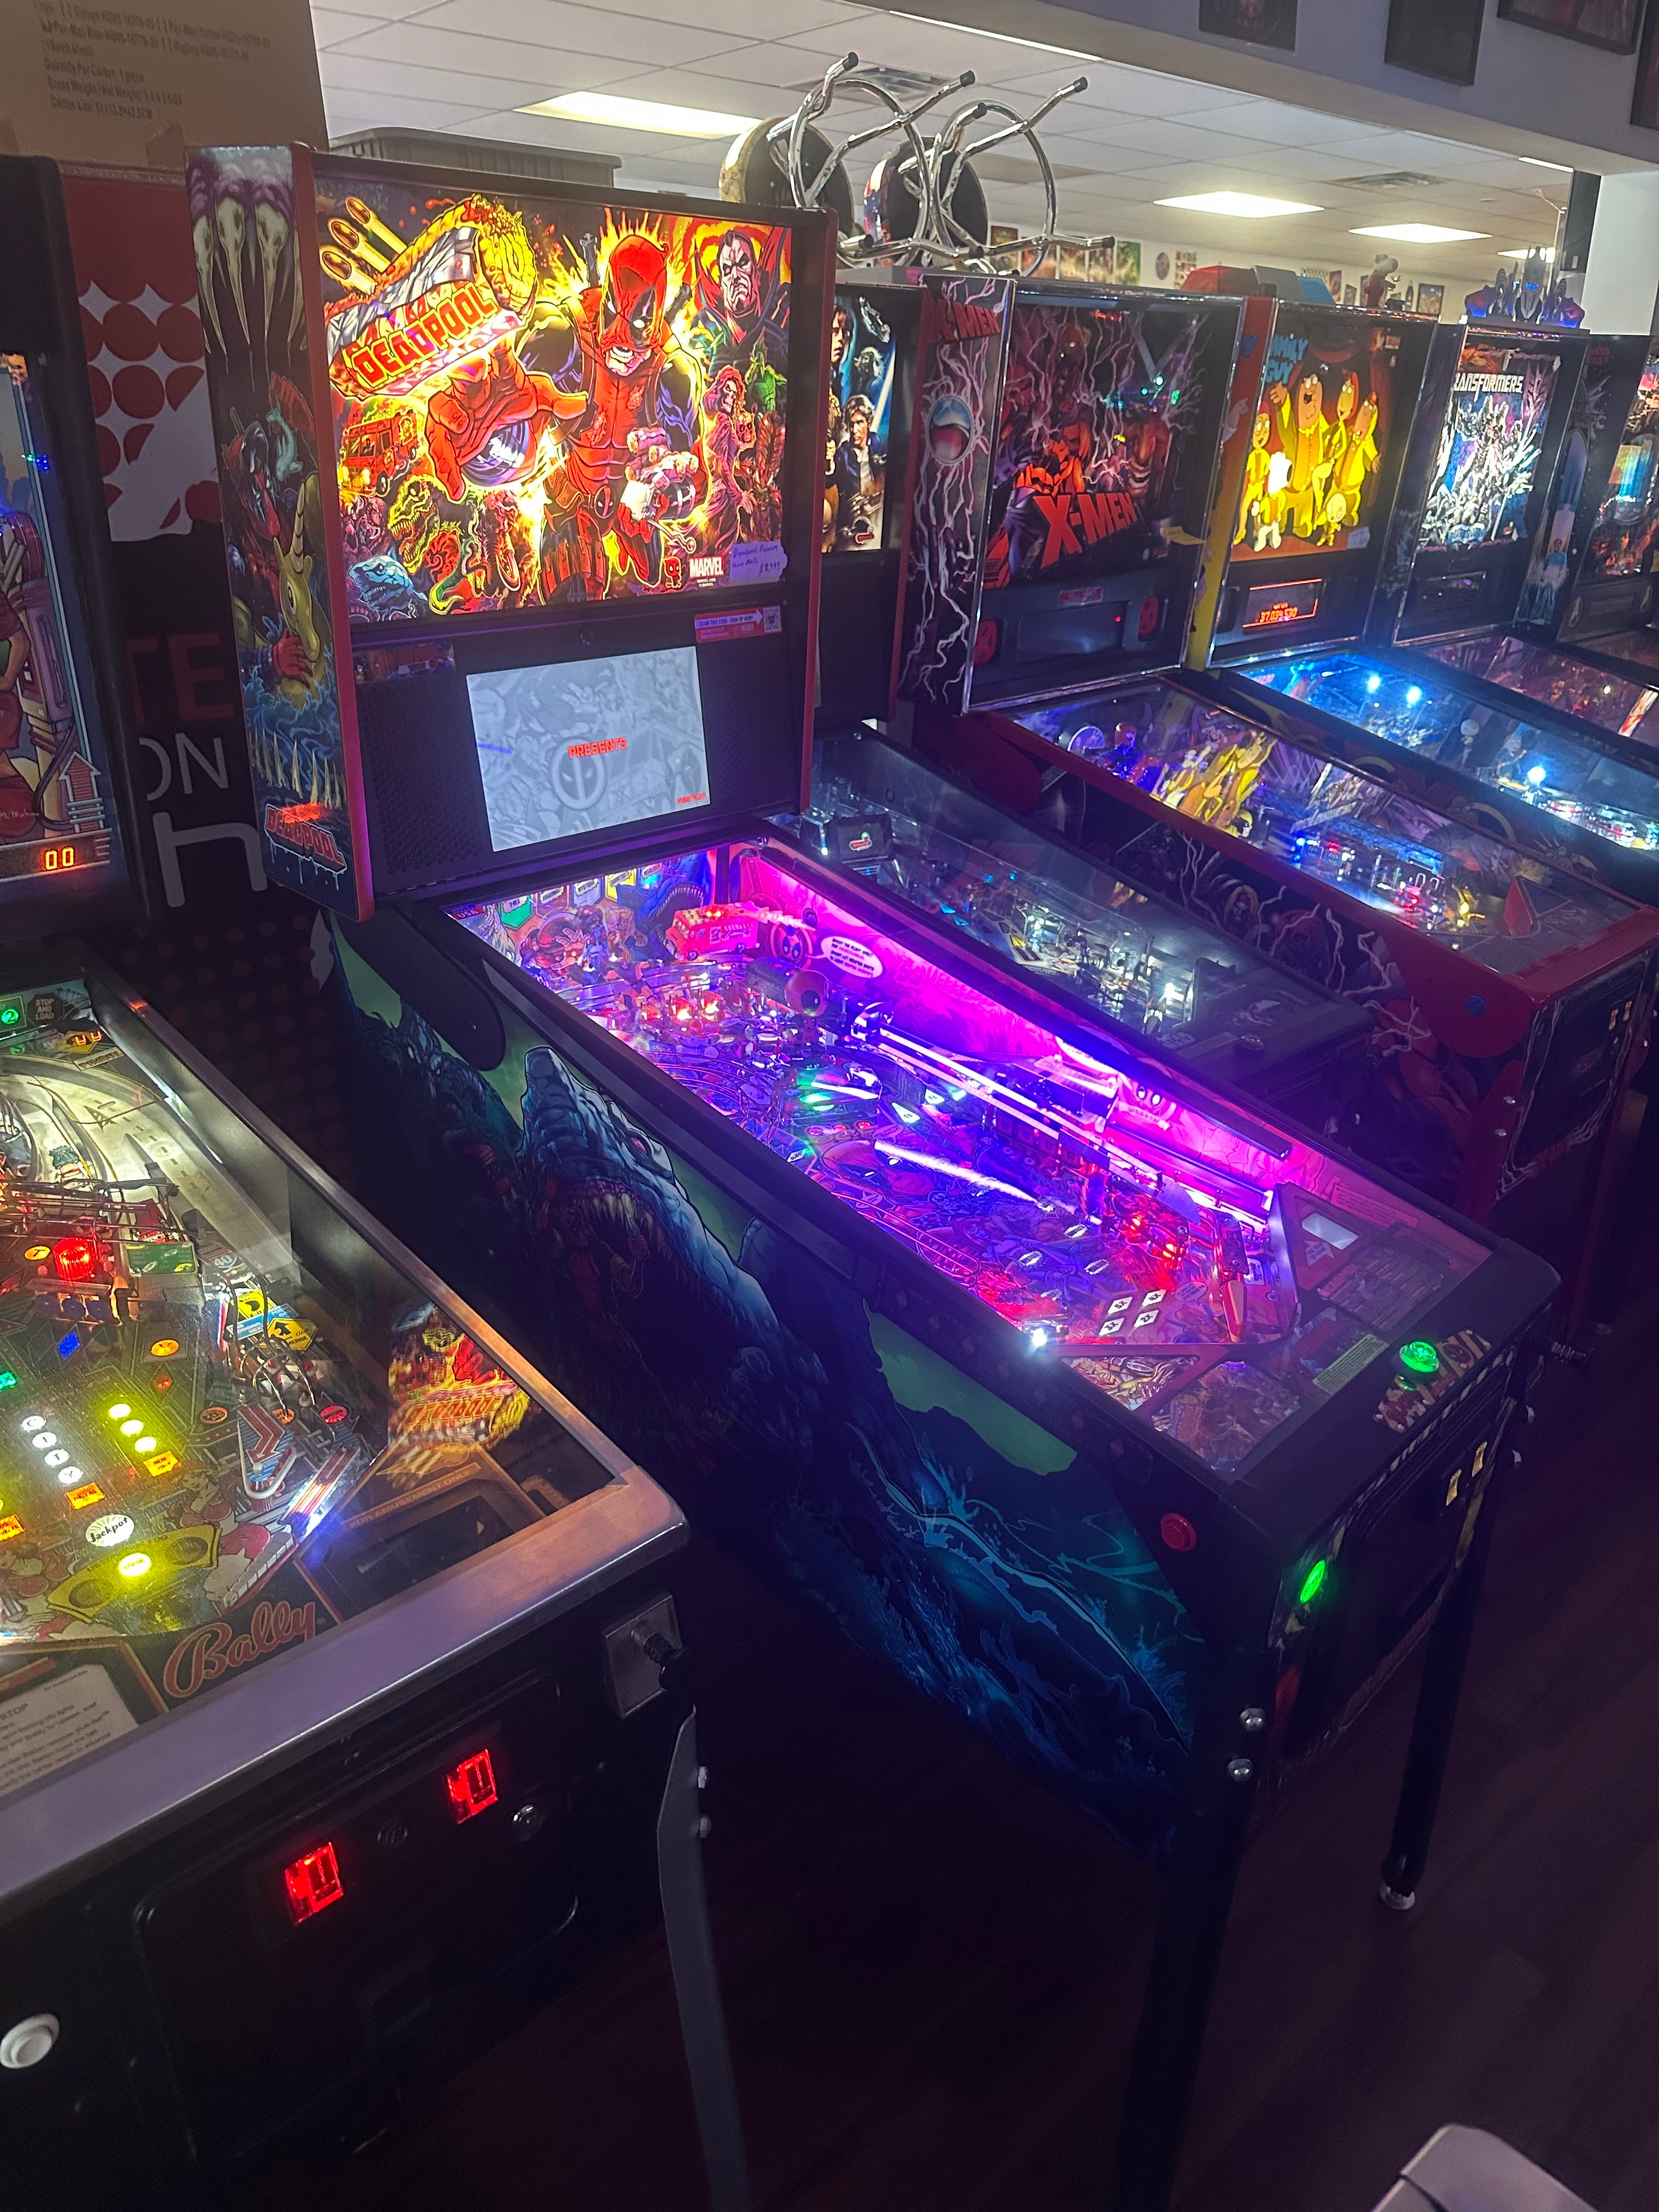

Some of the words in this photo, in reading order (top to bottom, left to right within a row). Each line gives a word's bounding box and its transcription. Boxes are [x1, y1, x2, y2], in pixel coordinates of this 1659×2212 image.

[918, 292, 1001, 350] X-MEN
[351, 281, 500, 388] DEADPOOL
[1270, 334, 1308, 362] AMILY
[1265, 358, 1294, 384] GUY
[1032, 492, 1138, 569] X-MEN
[690, 556, 724, 577] MARVEL
[568, 737, 628, 759] PRESENTS
[265, 805, 351, 870] DEADPOOL
[46, 847, 74, 870] 00
[458, 909, 478, 919] USA
[509, 899, 521, 908] T-REX
[35, 998, 54, 1006] STOP
[6, 1011, 16, 1023] 2
[215, 1255, 233, 1268] 40
[1114, 1300, 1128, 1310] 5X
[1148, 1293, 1161, 1301] 4X
[1104, 1321, 1119, 1331] 3X
[1140, 1313, 1154, 1323] 2X
[375, 1483, 443, 1516] AMUSEMENT
[446, 1469, 471, 1486] ONLY
[90, 1516, 128, 1543] Jackpot
[163, 1601, 315, 1698] Bally
